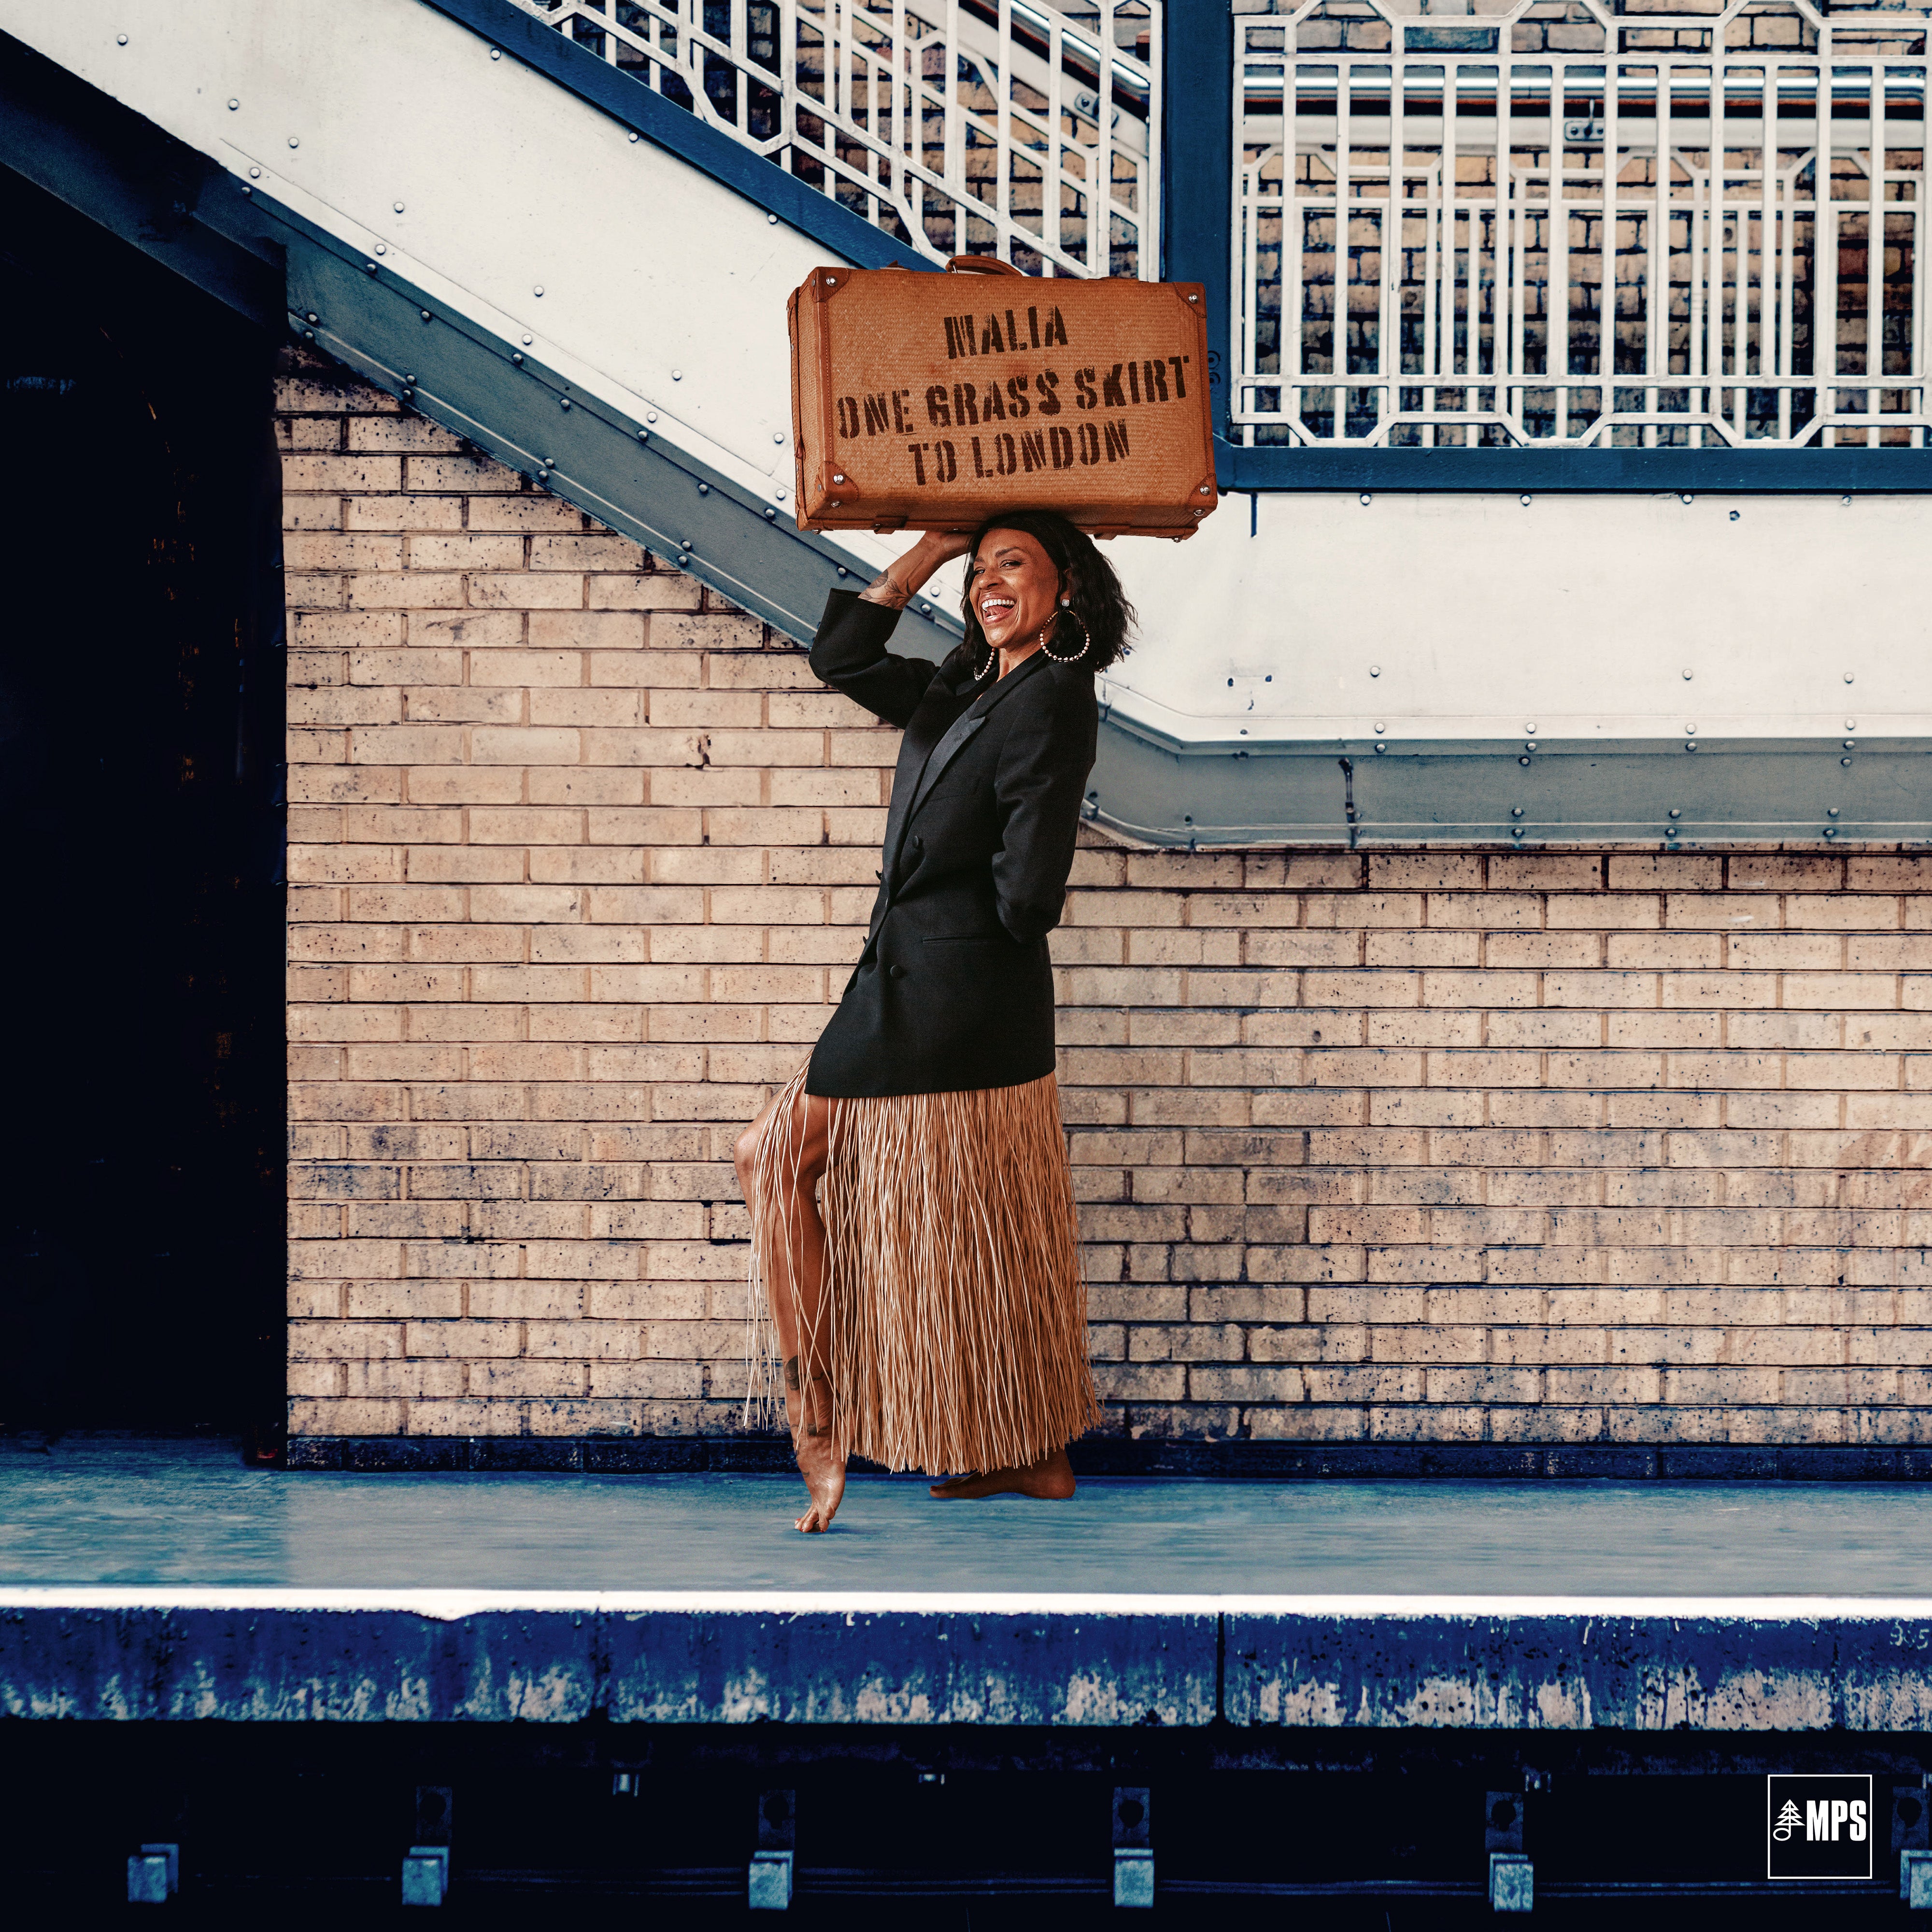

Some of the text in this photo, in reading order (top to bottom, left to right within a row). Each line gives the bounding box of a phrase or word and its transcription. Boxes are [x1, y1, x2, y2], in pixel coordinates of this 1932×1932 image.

[944, 305, 1068, 359] MALIA
[838, 355, 1190, 439] ONE GRASS SKIRT
[908, 418, 1129, 485] TO LONDON
